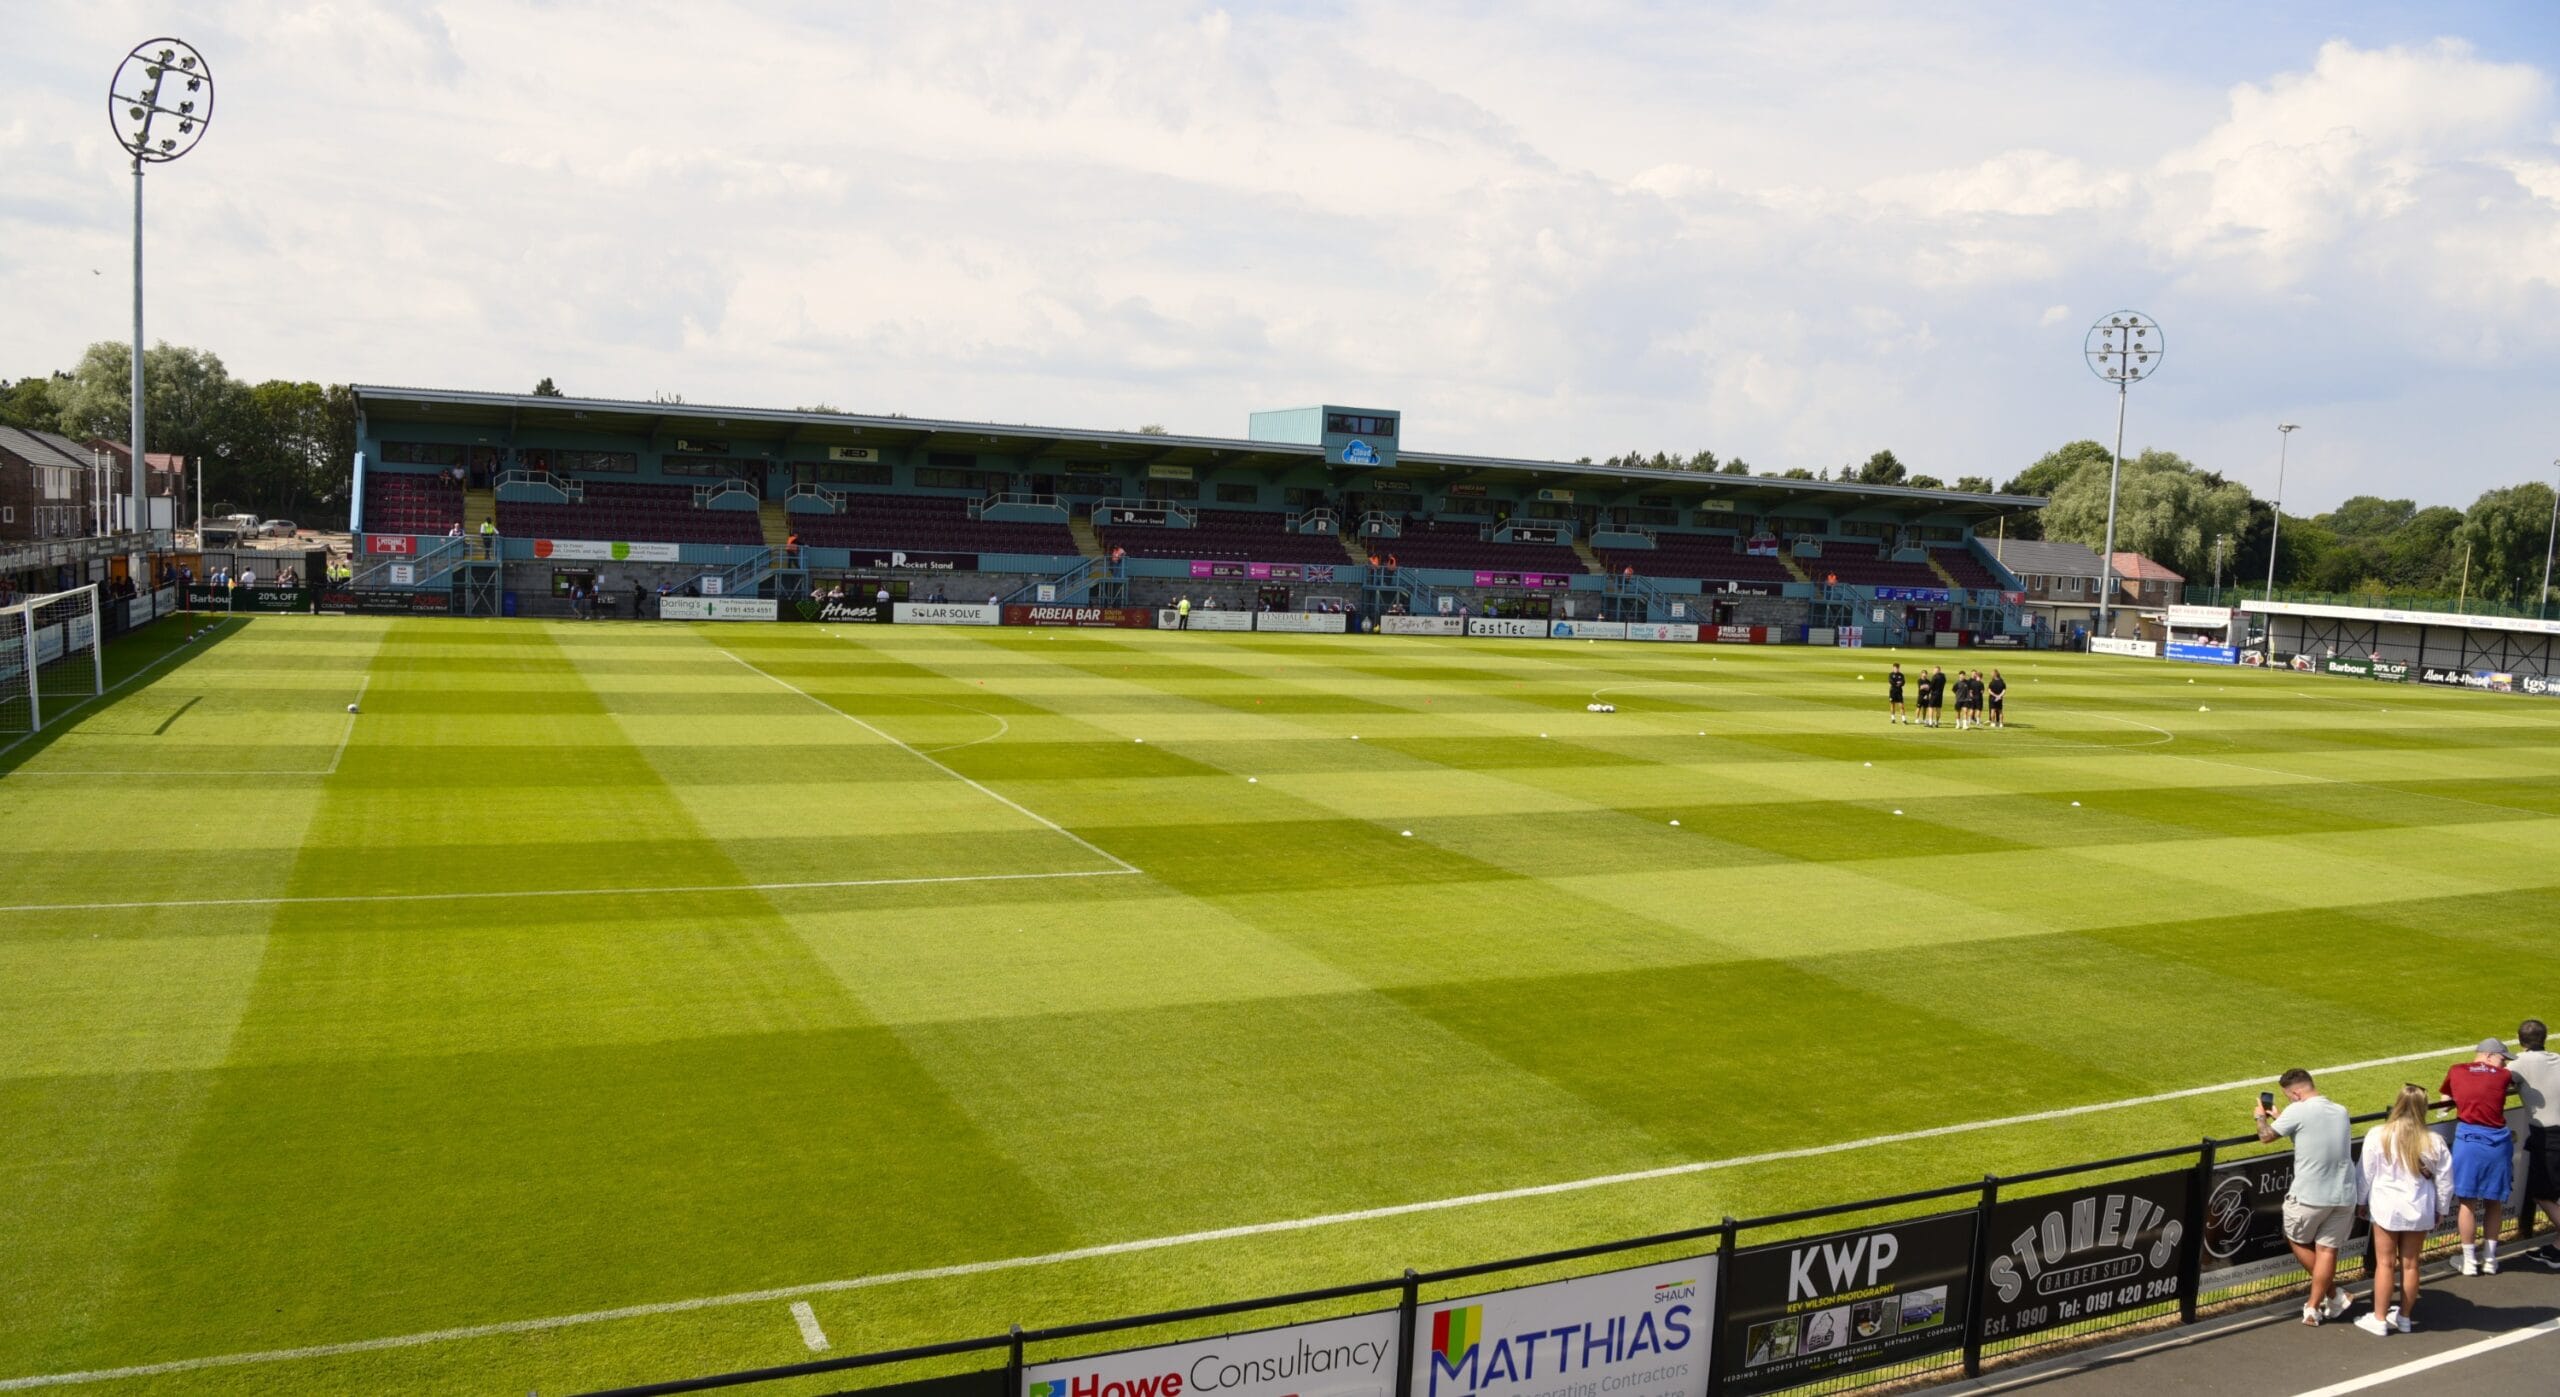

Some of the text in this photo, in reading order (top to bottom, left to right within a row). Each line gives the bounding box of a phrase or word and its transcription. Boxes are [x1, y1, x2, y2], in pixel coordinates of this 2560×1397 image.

[874, 552, 954, 569] The Rocket Stand
[190, 593, 232, 604] Barbour
[258, 592, 298, 601] 20% OFF
[661, 599, 701, 610] Darling's
[819, 602, 878, 620] fitness
[911, 607, 982, 619] SOLAR SOLVE
[1029, 607, 1101, 621] ARBEIA BAR
[1470, 620, 1526, 635] CastTec
[2329, 661, 2368, 674] Barbour
[2373, 663, 2408, 674] 20% OFF
[2523, 676, 2547, 694] tgs
[1989, 1194, 2183, 1303] STONEY'S
[1788, 1233, 1899, 1302] KWP
[2045, 1258, 2137, 1291] BARBER SHOP
[1654, 1286, 1696, 1304] SHAUN
[1787, 1284, 1896, 1314] KEV WILSON PHOTOGRAPHY
[1984, 1275, 2178, 1337] Est. 1990 Tel: 0191 420 2848
[1428, 1303, 1692, 1397] MATTHIAS
[1071, 1338, 1389, 1397] Howe Consultancy
[1511, 1363, 1689, 1397] rating Contractors
